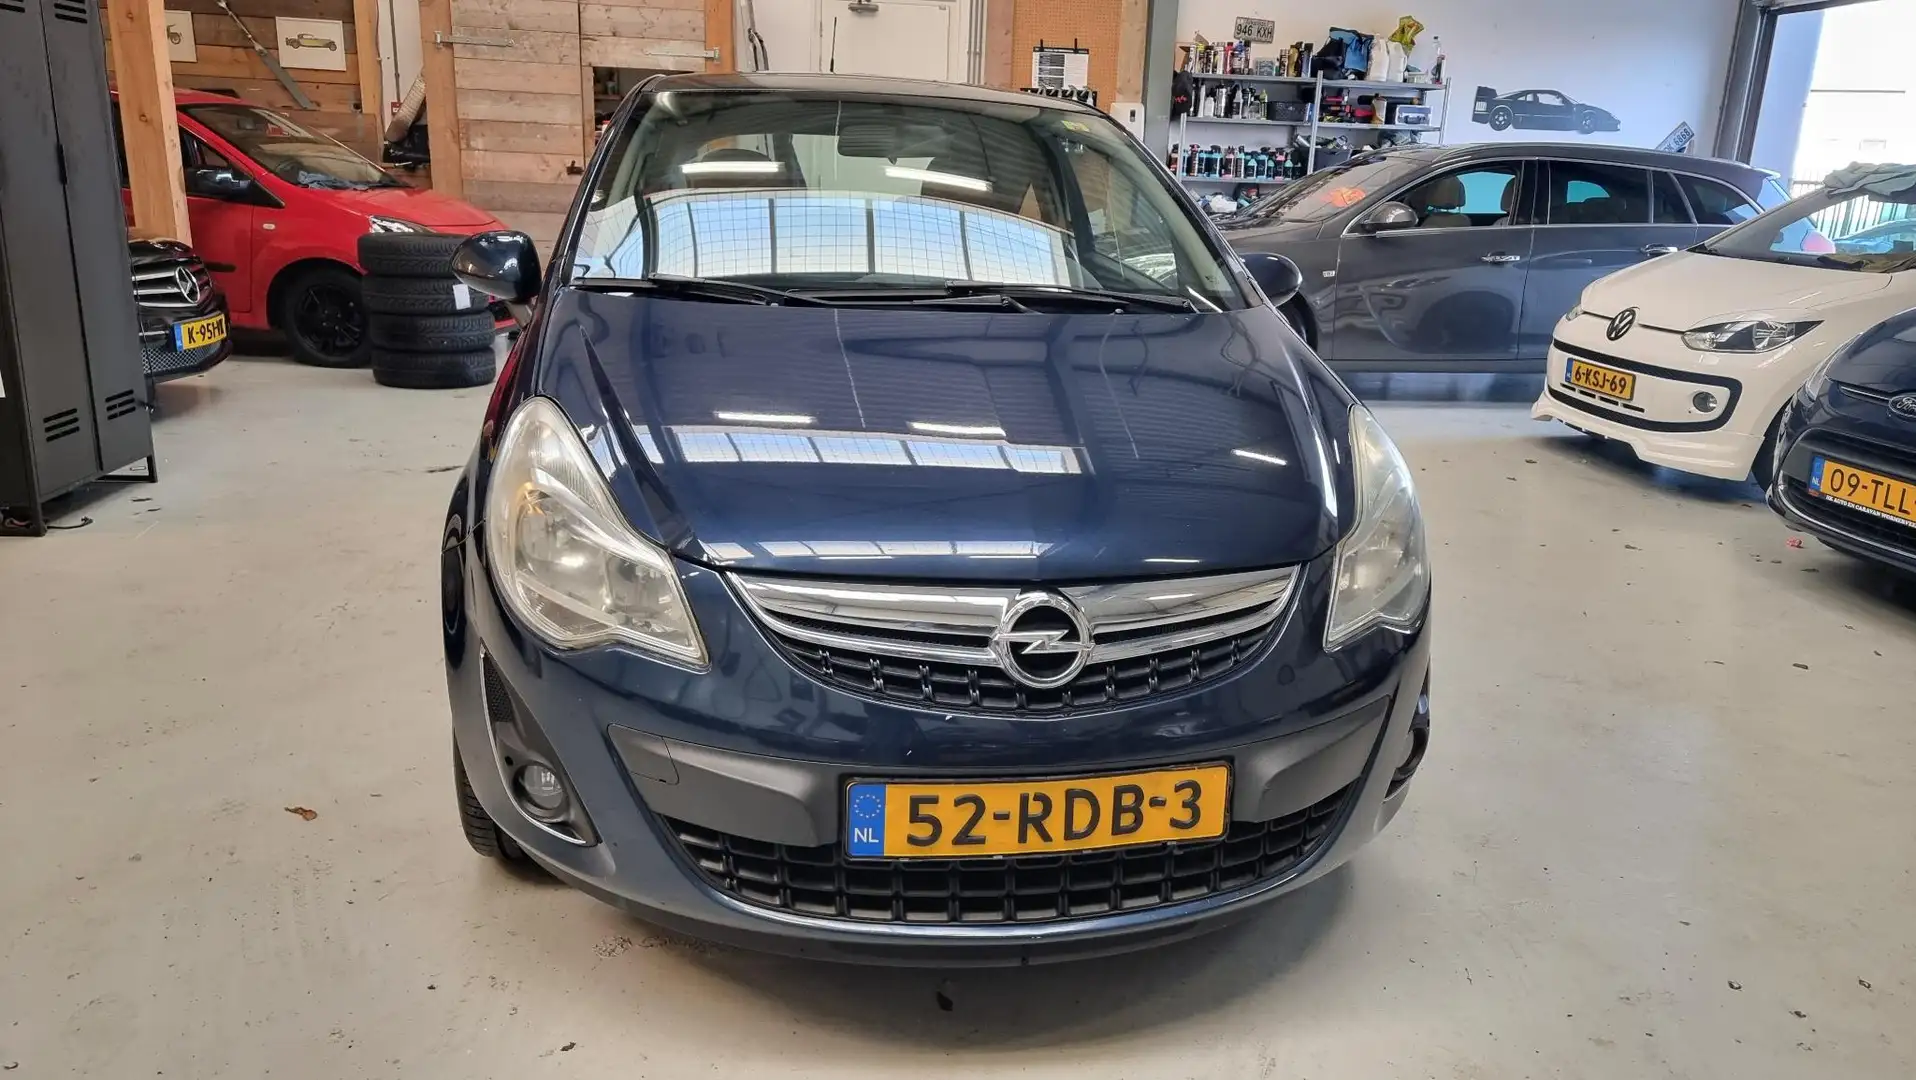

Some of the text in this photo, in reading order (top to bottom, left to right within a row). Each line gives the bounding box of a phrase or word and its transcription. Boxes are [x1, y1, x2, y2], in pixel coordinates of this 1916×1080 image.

[1236, 24, 1273, 38] 946 KXH
[1575, 366, 1627, 394] 6-KSJ-69
[1811, 476, 1820, 486] NL
[906, 779, 1202, 847] 52-RDB-3
[854, 827, 880, 844] NL
